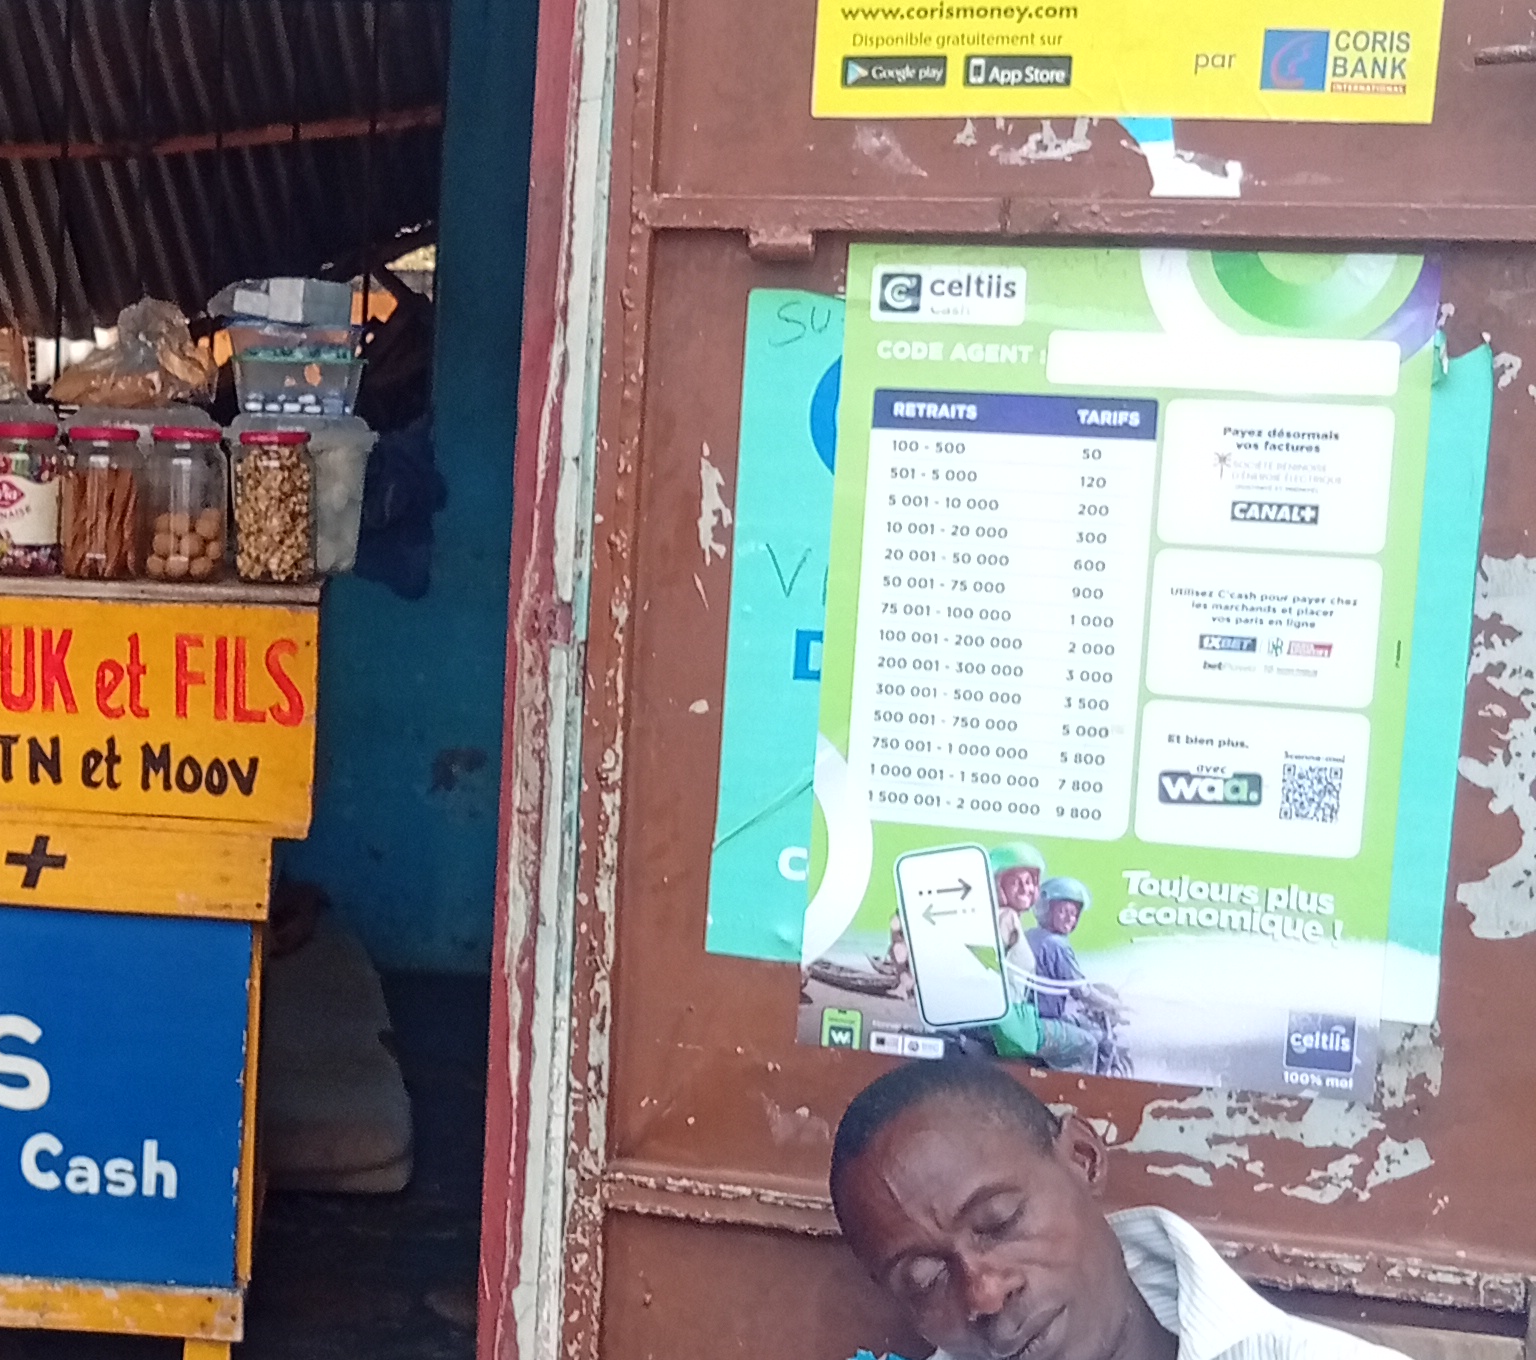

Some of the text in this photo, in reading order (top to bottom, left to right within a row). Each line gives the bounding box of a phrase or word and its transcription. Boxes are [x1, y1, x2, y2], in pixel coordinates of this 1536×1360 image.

[840, 0, 1079, 24] www.corismoney.com
[852, 31, 1063, 49] Disponible gratuitement sur
[1334, 29, 1411, 53] CORIS
[871, 63, 944, 83] Google play
[1194, 52, 1237, 75] par
[1331, 56, 1407, 80] BANK
[988, 65, 1066, 86] App Store
[929, 272, 1017, 299] celtiis
[876, 338, 945, 362] CODE
[949, 340, 1035, 365] AGENT
[892, 401, 978, 421] RETRAITS
[1076, 408, 1142, 428] TARIFS
[893, 440, 966, 454] 100 500
[1082, 448, 1102, 460] 50
[890, 467, 916, 480] 501
[945, 469, 978, 482] 000
[1081, 476, 1107, 488] 120
[901, 495, 929, 508] 001
[946, 497, 962, 509] 10
[966, 498, 999, 511] 000
[1078, 504, 1109, 516] 200
[1233, 502, 1316, 522] CANAL+
[887, 521, 1008, 539] 10 001 20 000
[1076, 532, 1107, 544] 300
[1211, 602, 1277, 615] marchands
[1260, 592, 1289, 603] pour
[1292, 594, 1326, 606] payer
[882, 602, 1012, 622] 75 001 100 000
[1080, 615, 1114, 628] 000
[877, 656, 1024, 677] 200 001 300 000
[1080, 670, 1113, 683] 000
[95, 633, 148, 720] et
[174, 632, 307, 727] FILS
[872, 736, 900, 750] 750
[904, 739, 931, 752] 001
[958, 743, 990, 757] 000
[995, 746, 1028, 760] 000
[1185, 734, 1214, 747] bien
[80, 737, 120, 790] et
[139, 741, 260, 797] Moov
[1074, 753, 1105, 766] 800
[880, 764, 912, 778] 000
[916, 767, 944, 781] 001
[971, 772, 1002, 785] 500
[1006, 774, 1039, 788] 000
[1071, 780, 1103, 793] 800
[878, 790, 909, 804] 500
[913, 794, 941, 807] 001
[970, 799, 1002, 812] 000
[1007, 802, 1040, 816] 000
[1070, 807, 1102, 821] 800
[1120, 869, 1335, 915] Toujours plus
[1117, 901, 1324, 943] économique
[1289, 1029, 1351, 1053] celtiis
[1283, 1070, 1323, 1086] 100%
[20, 1132, 178, 1200] Cash
